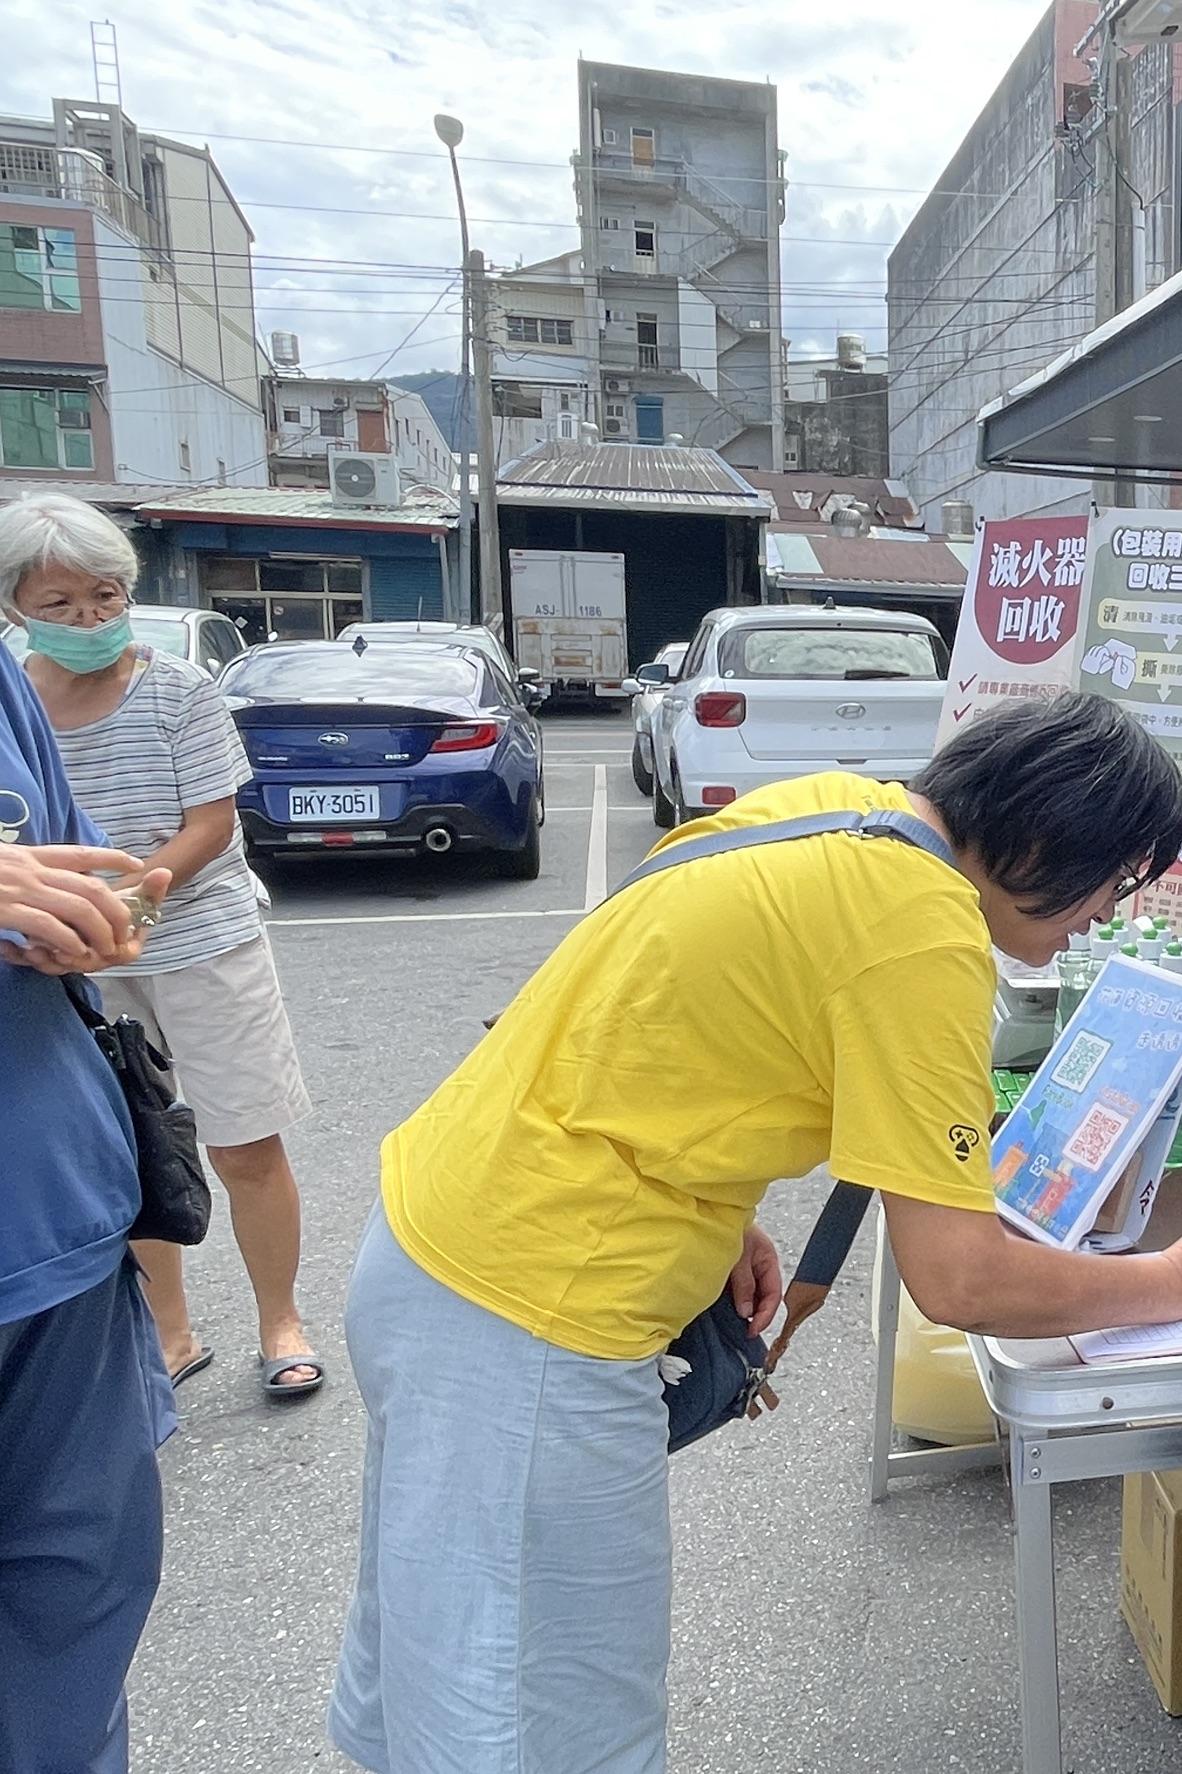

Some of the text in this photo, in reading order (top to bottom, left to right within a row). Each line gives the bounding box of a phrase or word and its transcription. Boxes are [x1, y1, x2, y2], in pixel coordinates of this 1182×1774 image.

[988, 537, 1086, 587] 滅火器
[580, 605, 602, 617] 1186
[996, 595, 1065, 643] 回收
[291, 794, 374, 816] BKY-3051
